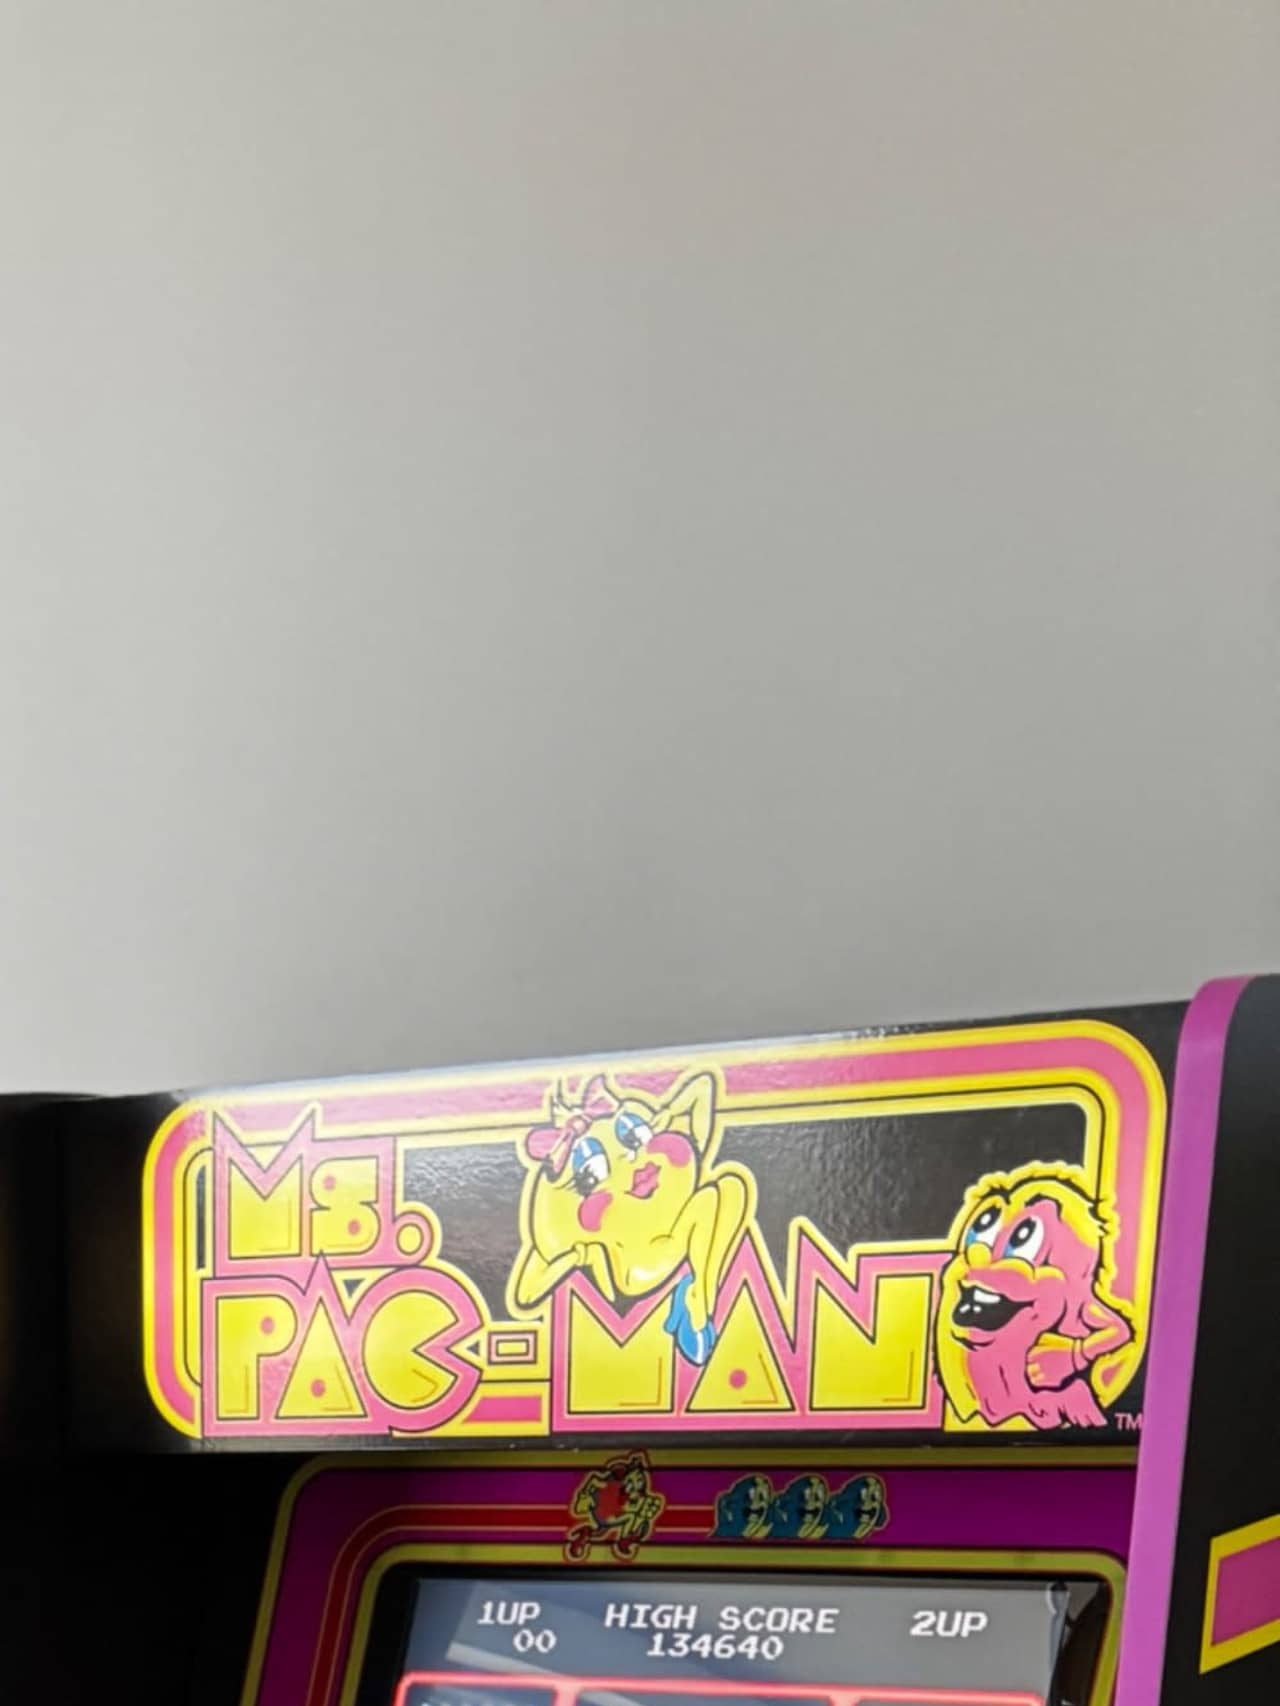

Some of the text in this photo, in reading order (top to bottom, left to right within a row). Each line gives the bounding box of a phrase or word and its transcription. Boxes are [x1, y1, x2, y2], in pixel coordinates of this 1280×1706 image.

[203, 1228, 946, 1434] PAC-MAN
[477, 1601, 989, 1638] 1UP HIGH SCORE 2UP
[513, 1629, 785, 1661] 00 134640
